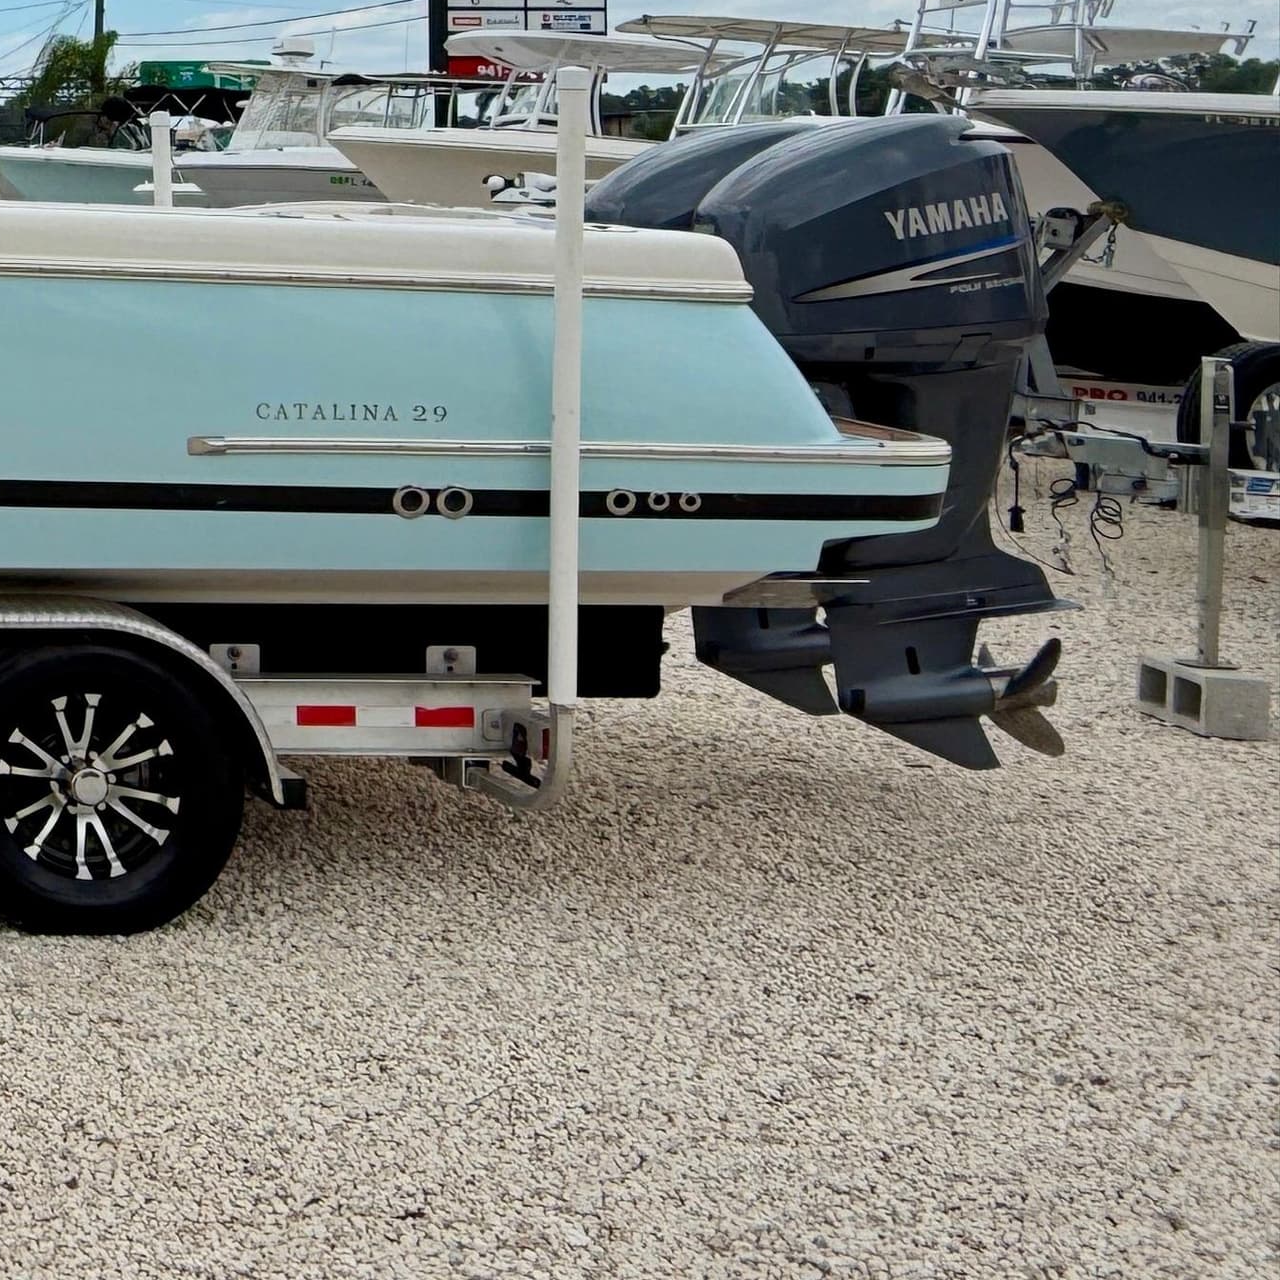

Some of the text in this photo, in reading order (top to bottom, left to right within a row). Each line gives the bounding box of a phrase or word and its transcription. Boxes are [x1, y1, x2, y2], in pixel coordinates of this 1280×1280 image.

[883, 192, 1009, 241] YAMAHA
[1071, 386, 1128, 401] PRO
[255, 402, 449, 423] CATALINA 29
